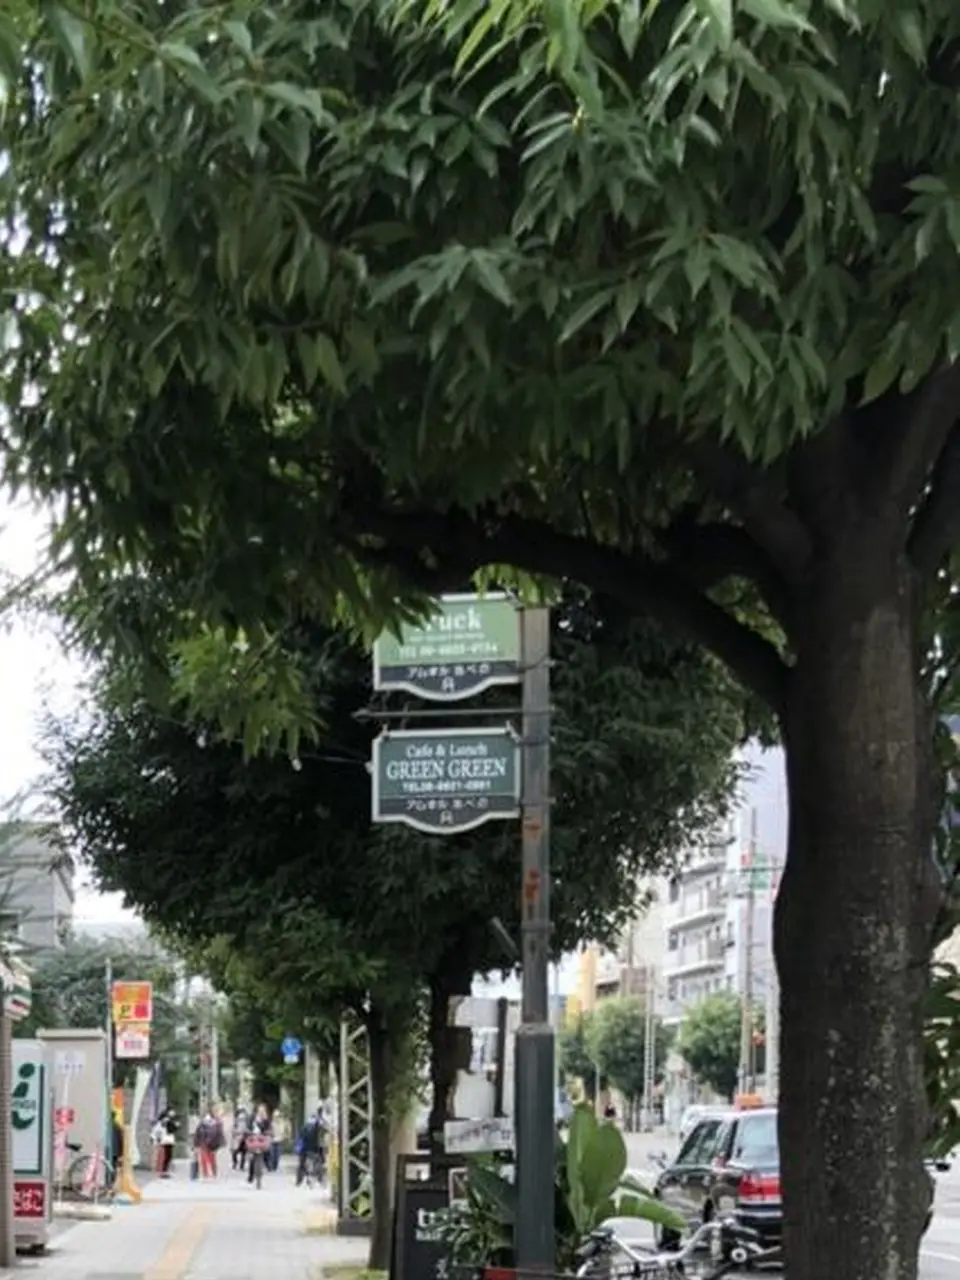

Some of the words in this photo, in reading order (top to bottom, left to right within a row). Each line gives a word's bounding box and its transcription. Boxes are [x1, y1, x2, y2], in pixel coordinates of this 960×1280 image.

[405, 743, 433, 758] Cafe
[435, 742, 446, 757] &
[449, 741, 488, 757] Lunch
[385, 758, 444, 780] GREEN
[447, 756, 507, 779] GREEN
